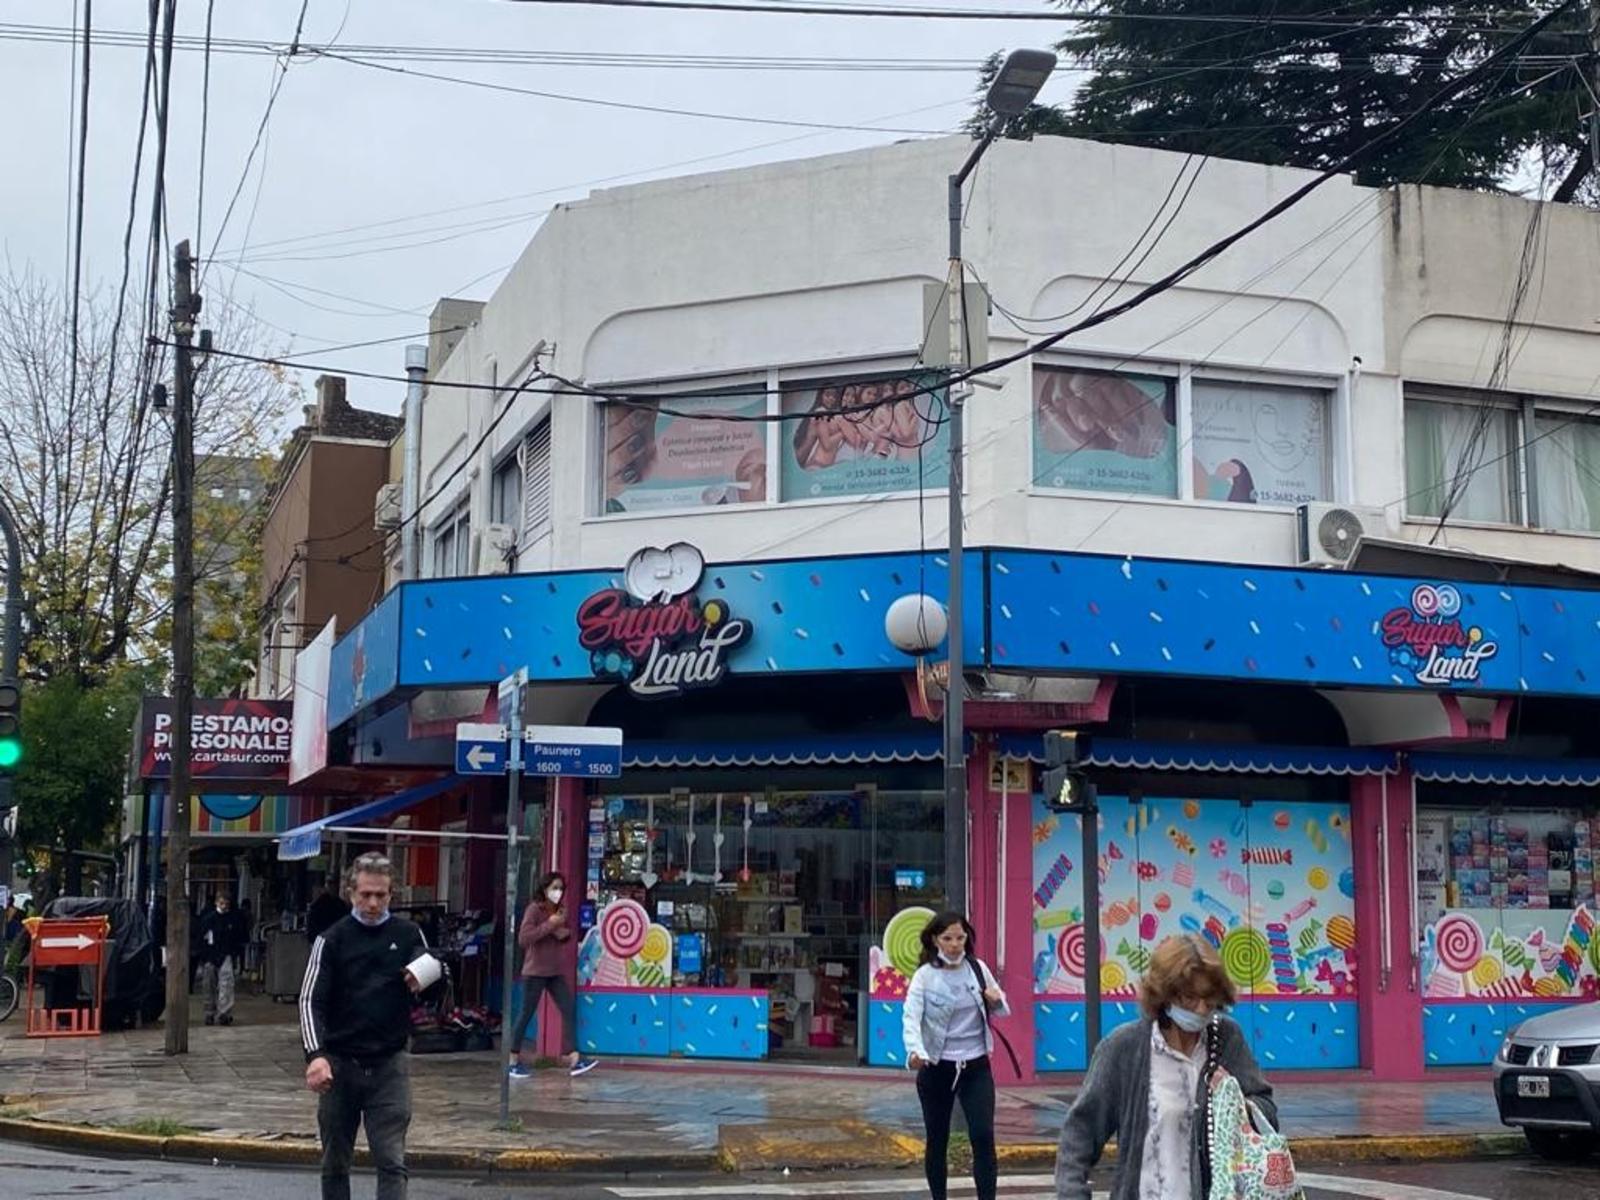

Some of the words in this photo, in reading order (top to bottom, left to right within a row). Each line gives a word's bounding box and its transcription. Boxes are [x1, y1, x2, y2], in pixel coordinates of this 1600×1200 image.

[579, 589, 701, 656] Sugar
[1383, 608, 1467, 657] Sugar
[630, 620, 744, 694] Land
[1415, 642, 1497, 683] Land
[155, 713, 292, 733] PESTAMO
[534, 745, 582, 757] Paunero
[536, 762, 562, 773] 1600
[588, 763, 613, 774] 1500
